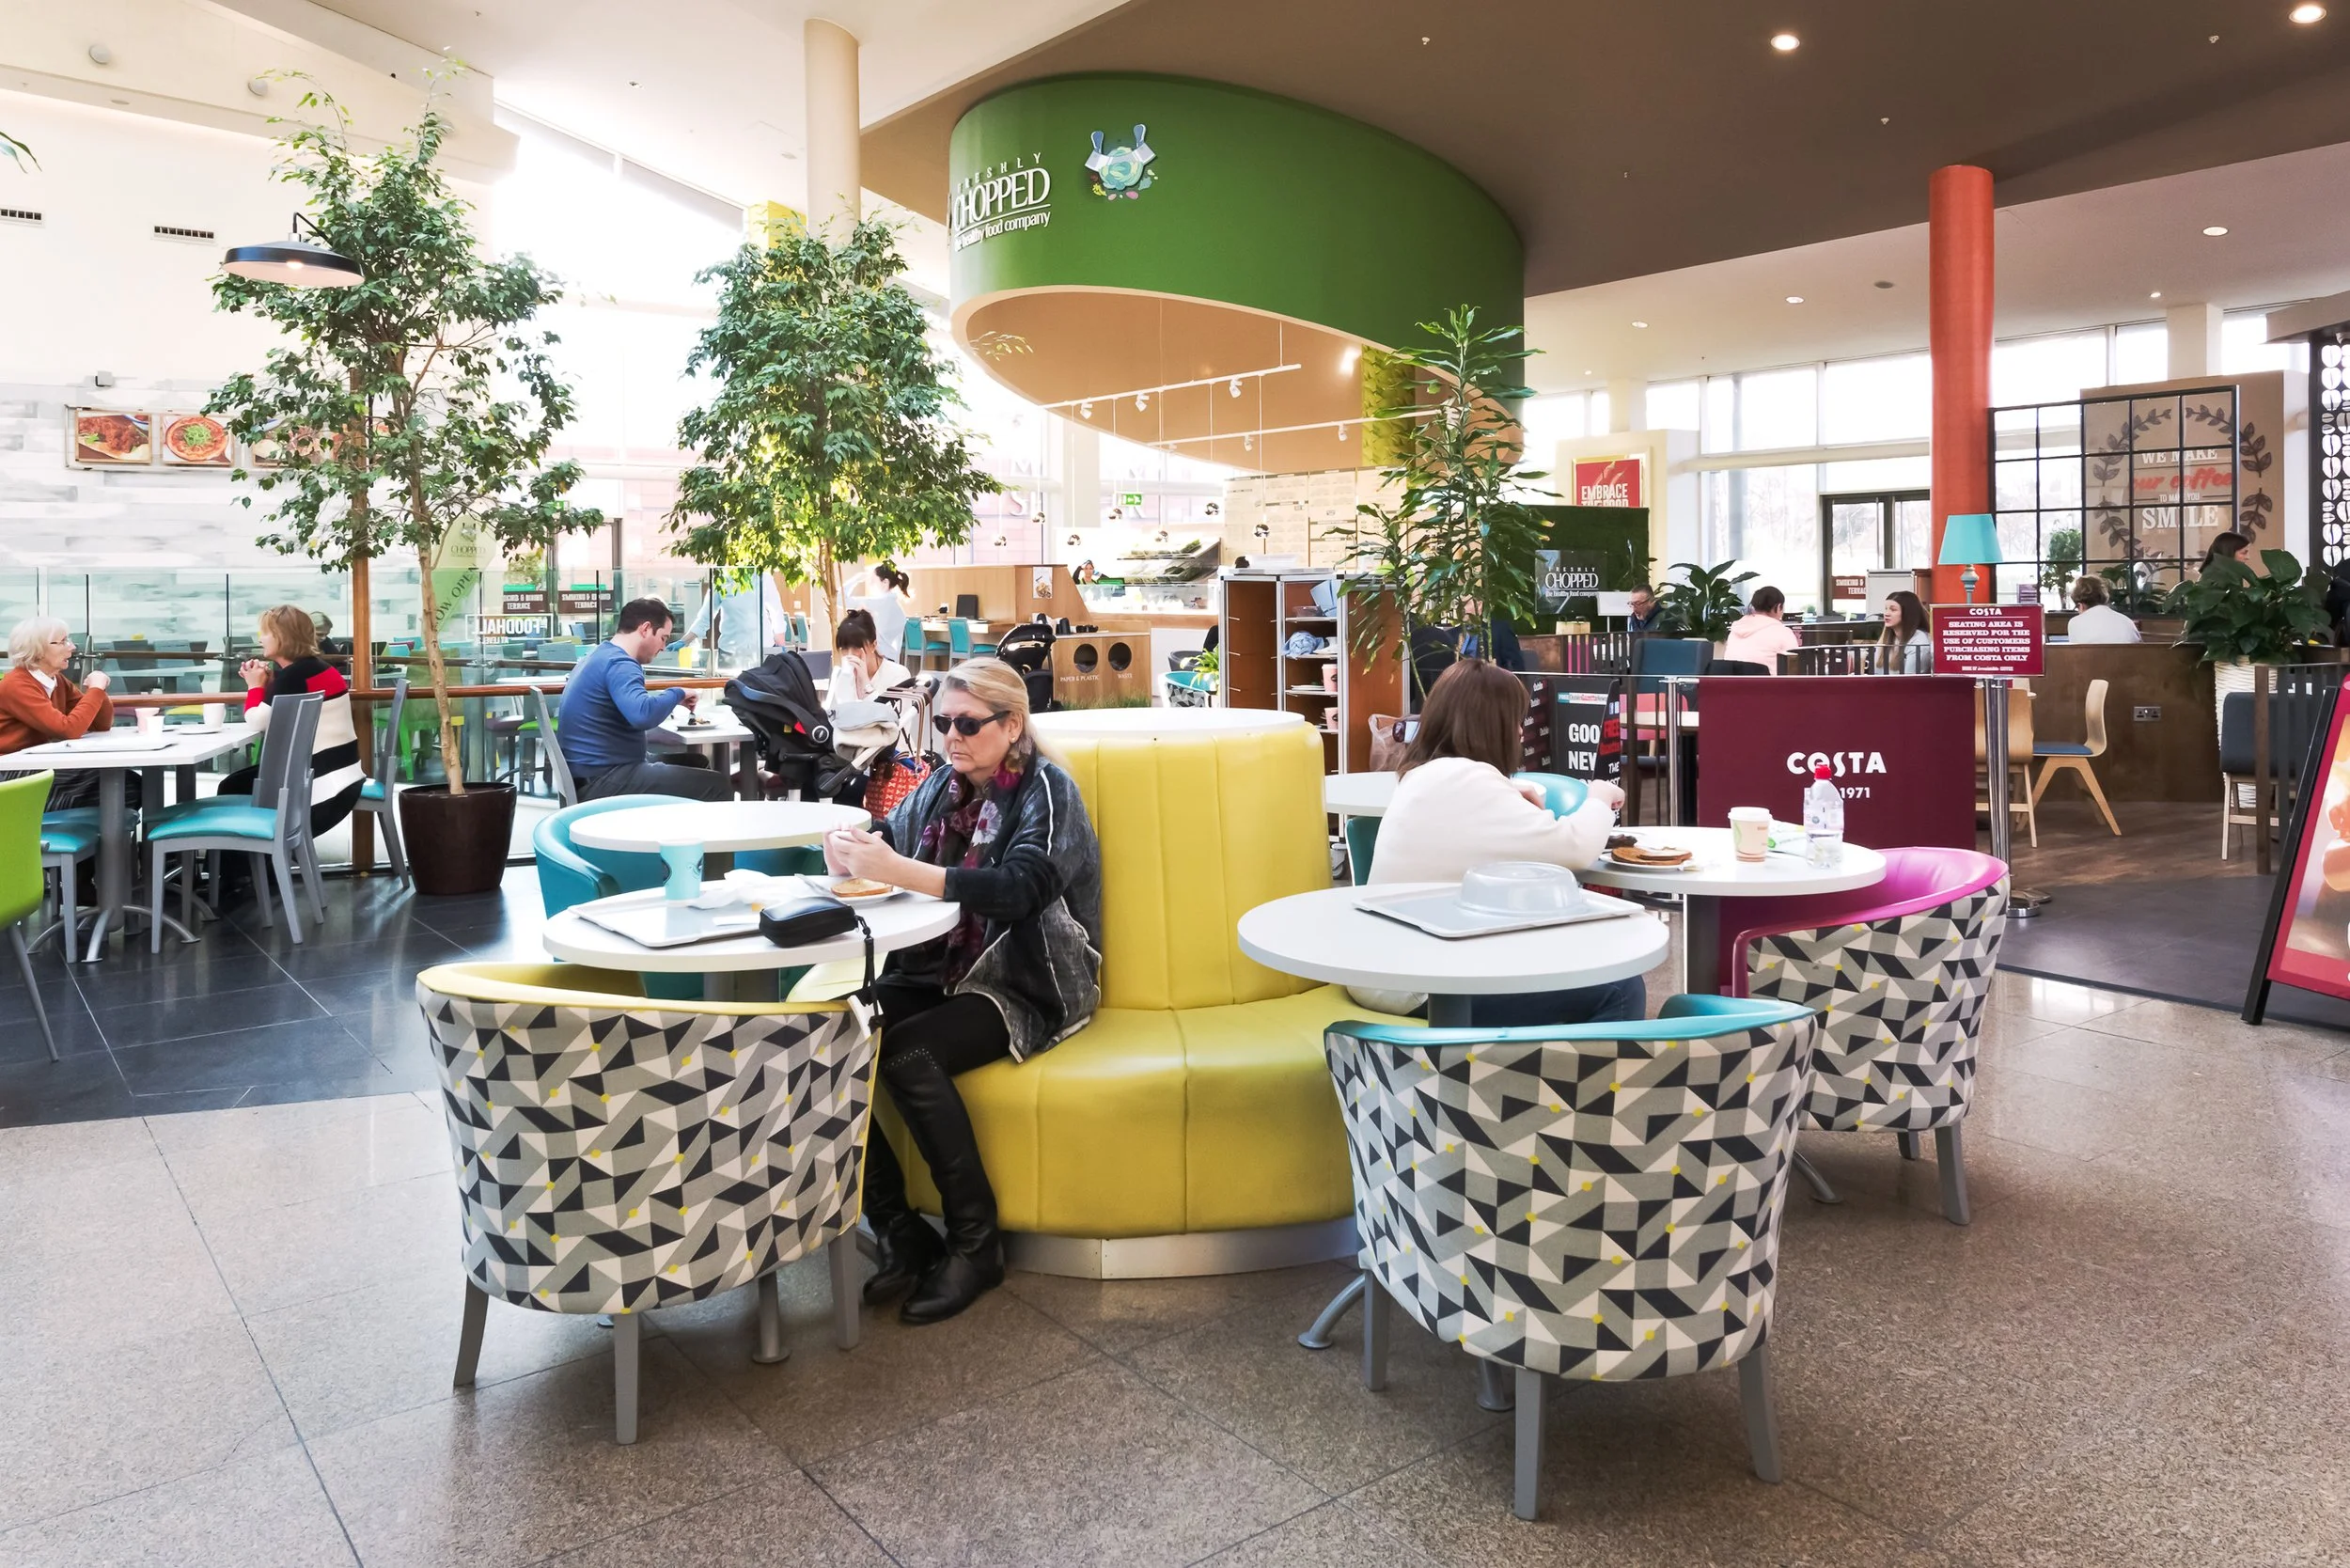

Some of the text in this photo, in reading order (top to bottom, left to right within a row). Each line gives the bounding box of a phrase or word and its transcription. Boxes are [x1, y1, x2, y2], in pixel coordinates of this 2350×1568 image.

[957, 152, 1041, 194] FRESHLY
[953, 167, 1051, 232] CHOPPED
[985, 218, 1003, 239] food
[1004, 212, 1051, 231] company
[2142, 451, 2167, 464] WE
[1581, 483, 1628, 500] EMBRACE
[2159, 494, 2168, 503] TO
[2187, 493, 2200, 501] YOU
[1544, 572, 1599, 588] CHOPPED
[1969, 607, 2002, 617] COSTA
[1568, 723, 1600, 744] GOO
[1786, 751, 1887, 777] COSTA
[1839, 787, 1871, 798] 1971
